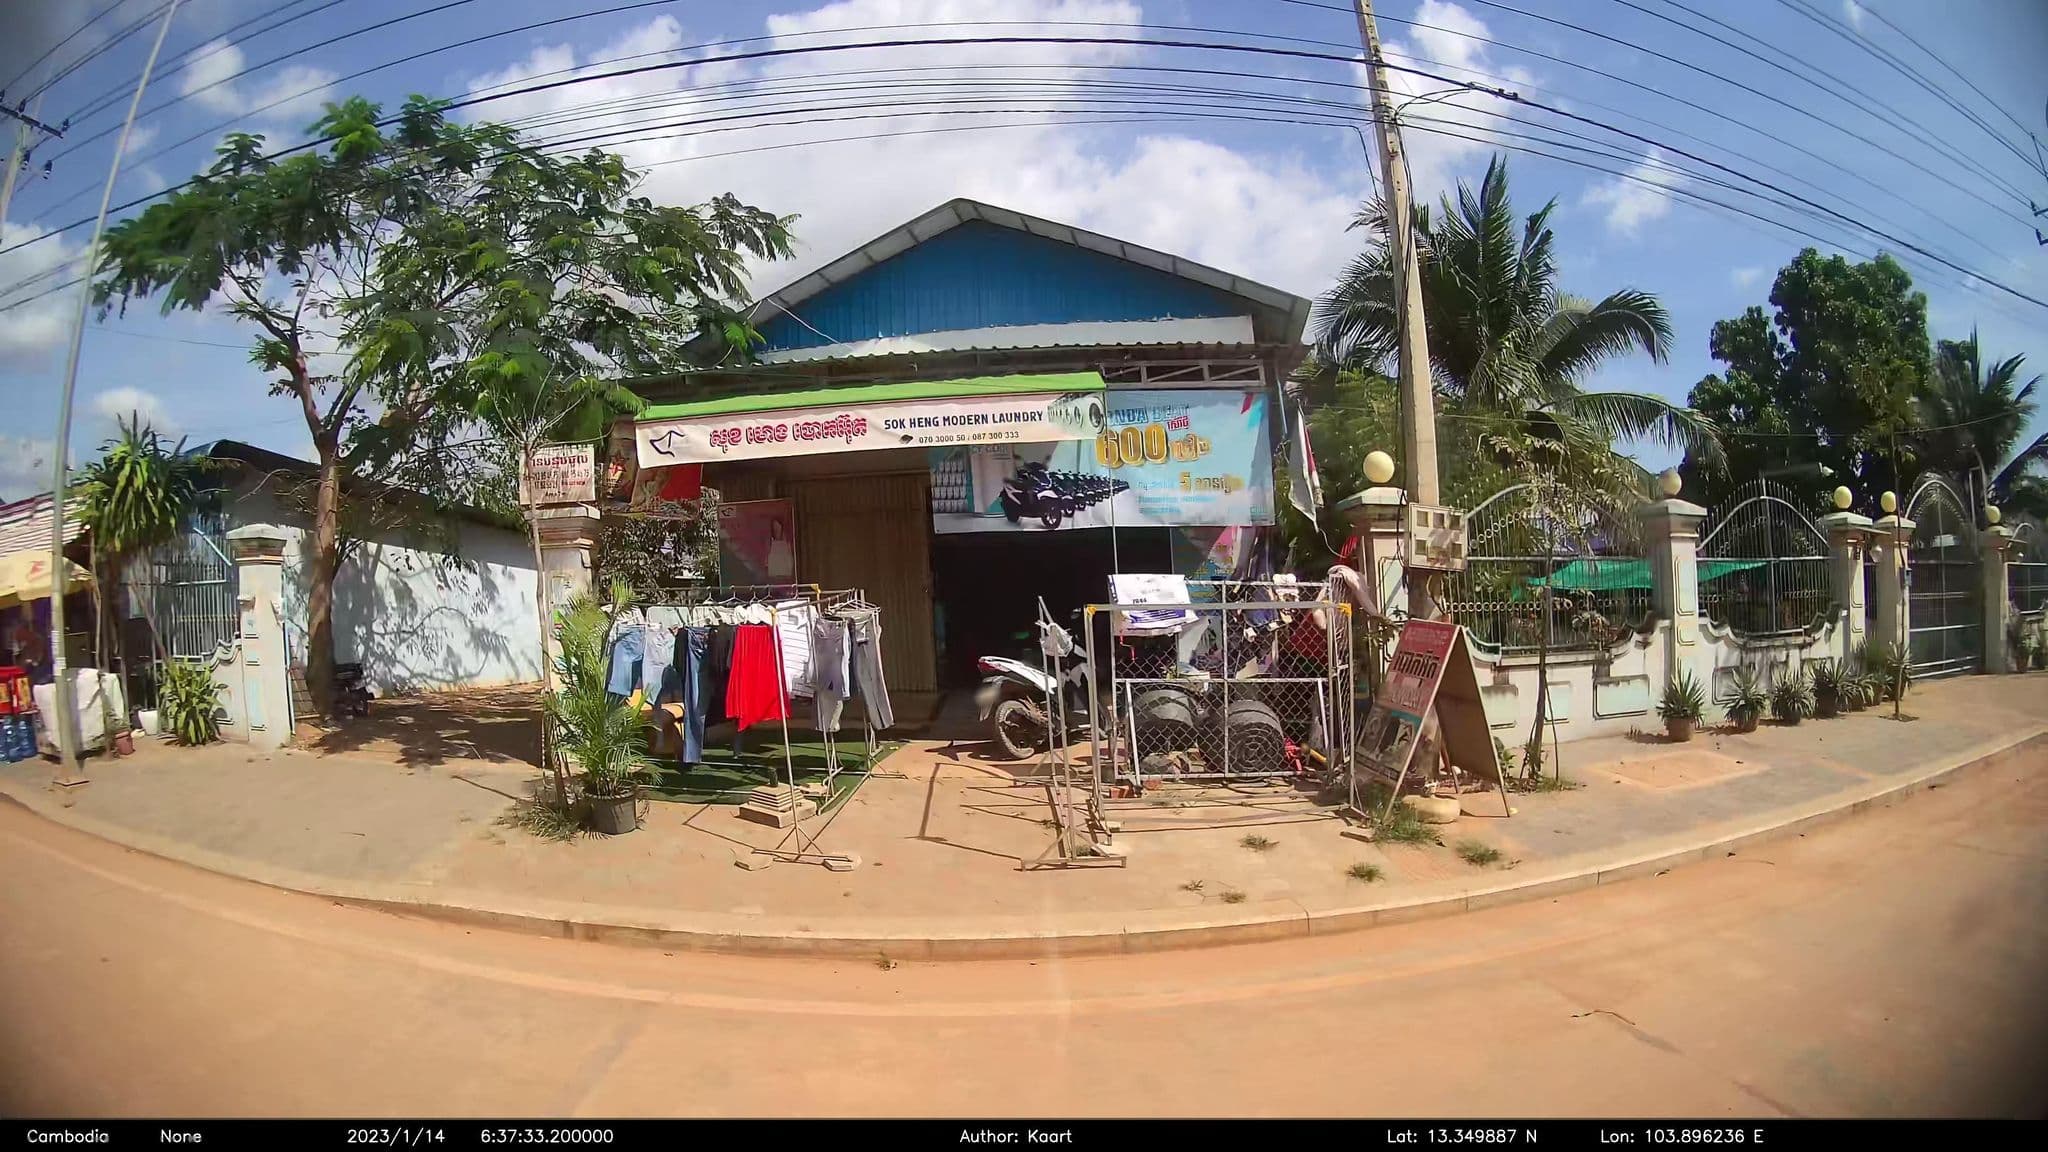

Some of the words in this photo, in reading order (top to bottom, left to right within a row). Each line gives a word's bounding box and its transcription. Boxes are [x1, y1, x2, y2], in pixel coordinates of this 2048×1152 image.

[884, 418, 906, 430] SOK
[909, 416, 940, 429] HENG
[942, 413, 989, 427] MODERN
[992, 410, 1043, 423] LAUNDRY
[1096, 422, 1168, 469] 600
